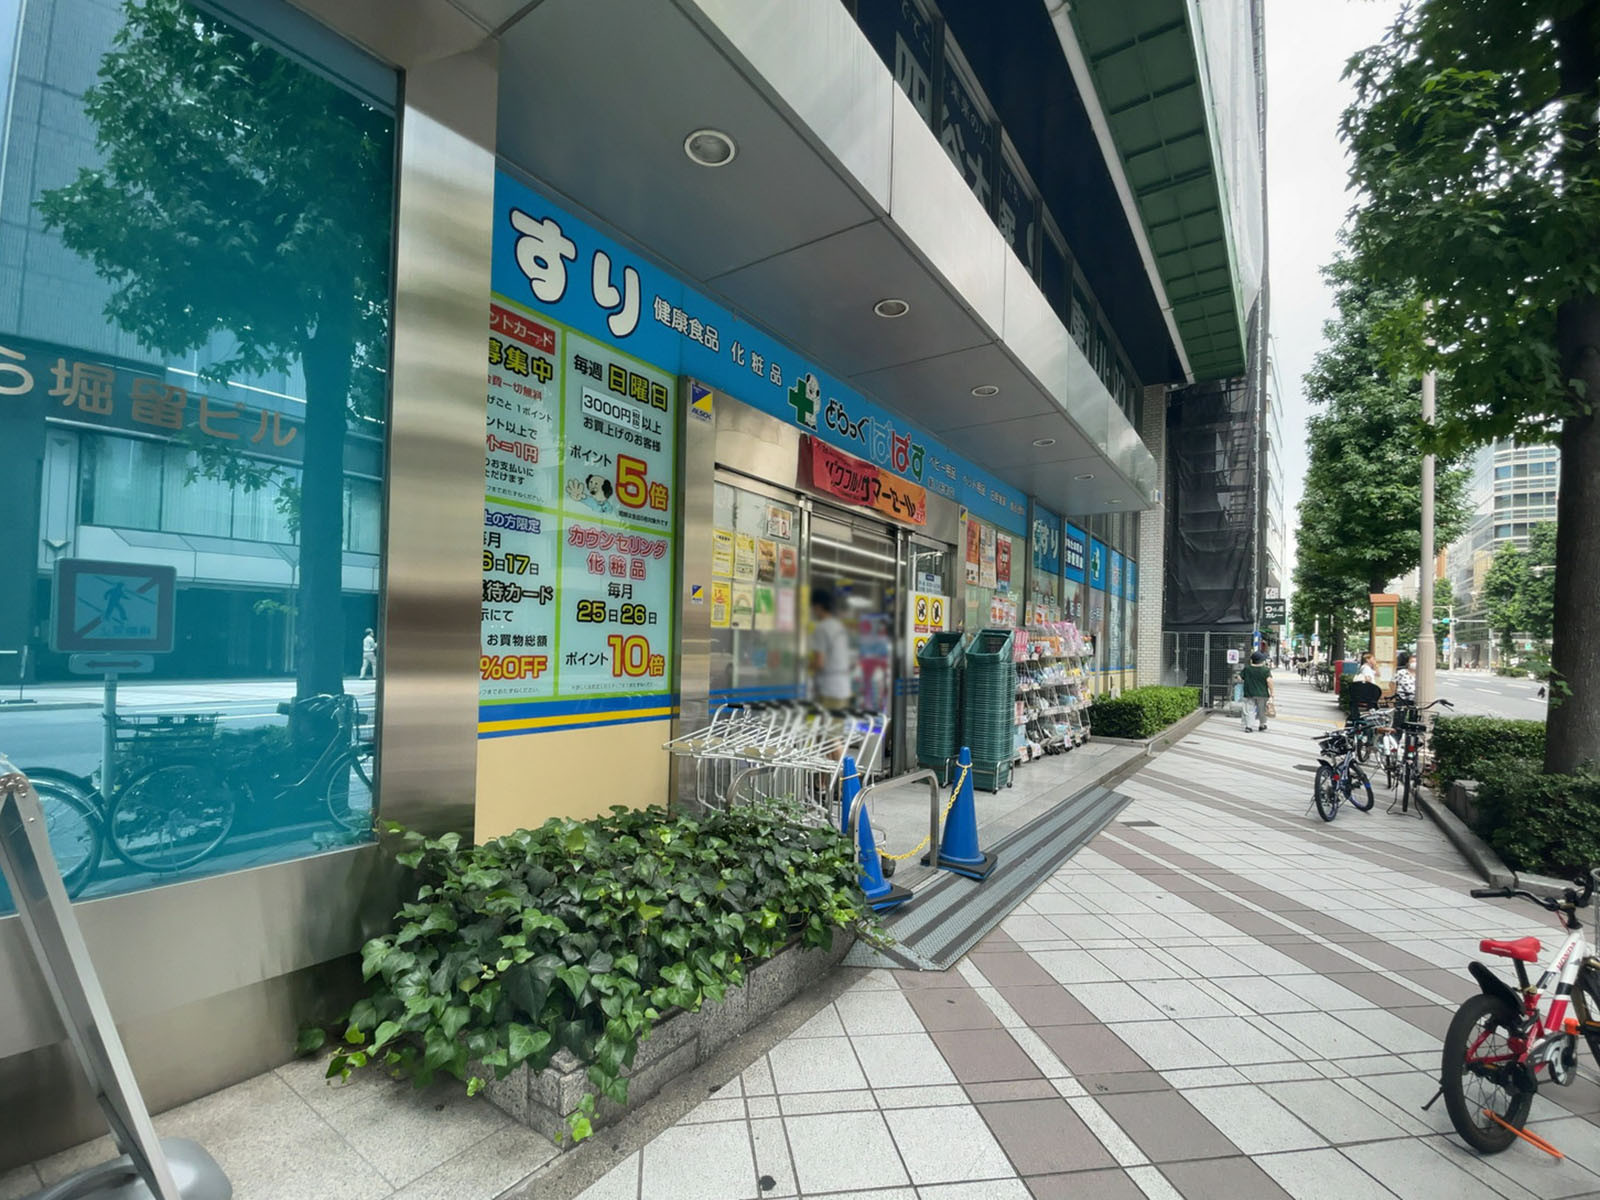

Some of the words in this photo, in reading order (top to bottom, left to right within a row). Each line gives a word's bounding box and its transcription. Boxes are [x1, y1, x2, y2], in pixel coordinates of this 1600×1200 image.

[509, 208, 641, 338] すり
[653, 295, 720, 353] 健康食品
[731, 340, 782, 387] 化粧品
[574, 354, 603, 382] 毎週
[608, 363, 668, 413] 日曜日
[486, 433, 539, 464] ト=1円
[583, 416, 661, 453] お買上げのお客様
[570, 444, 612, 468] ポイント
[484, 531, 501, 549] 月
[568, 524, 667, 560] カウンセリング
[587, 551, 646, 581] 化粧品
[607, 581, 633, 600] 毎月
[487, 633, 548, 648] お買物総額
[480, 654, 548, 681] %OFF
[565, 651, 609, 666] ポイント
[608, 634, 665, 678] 10倍
